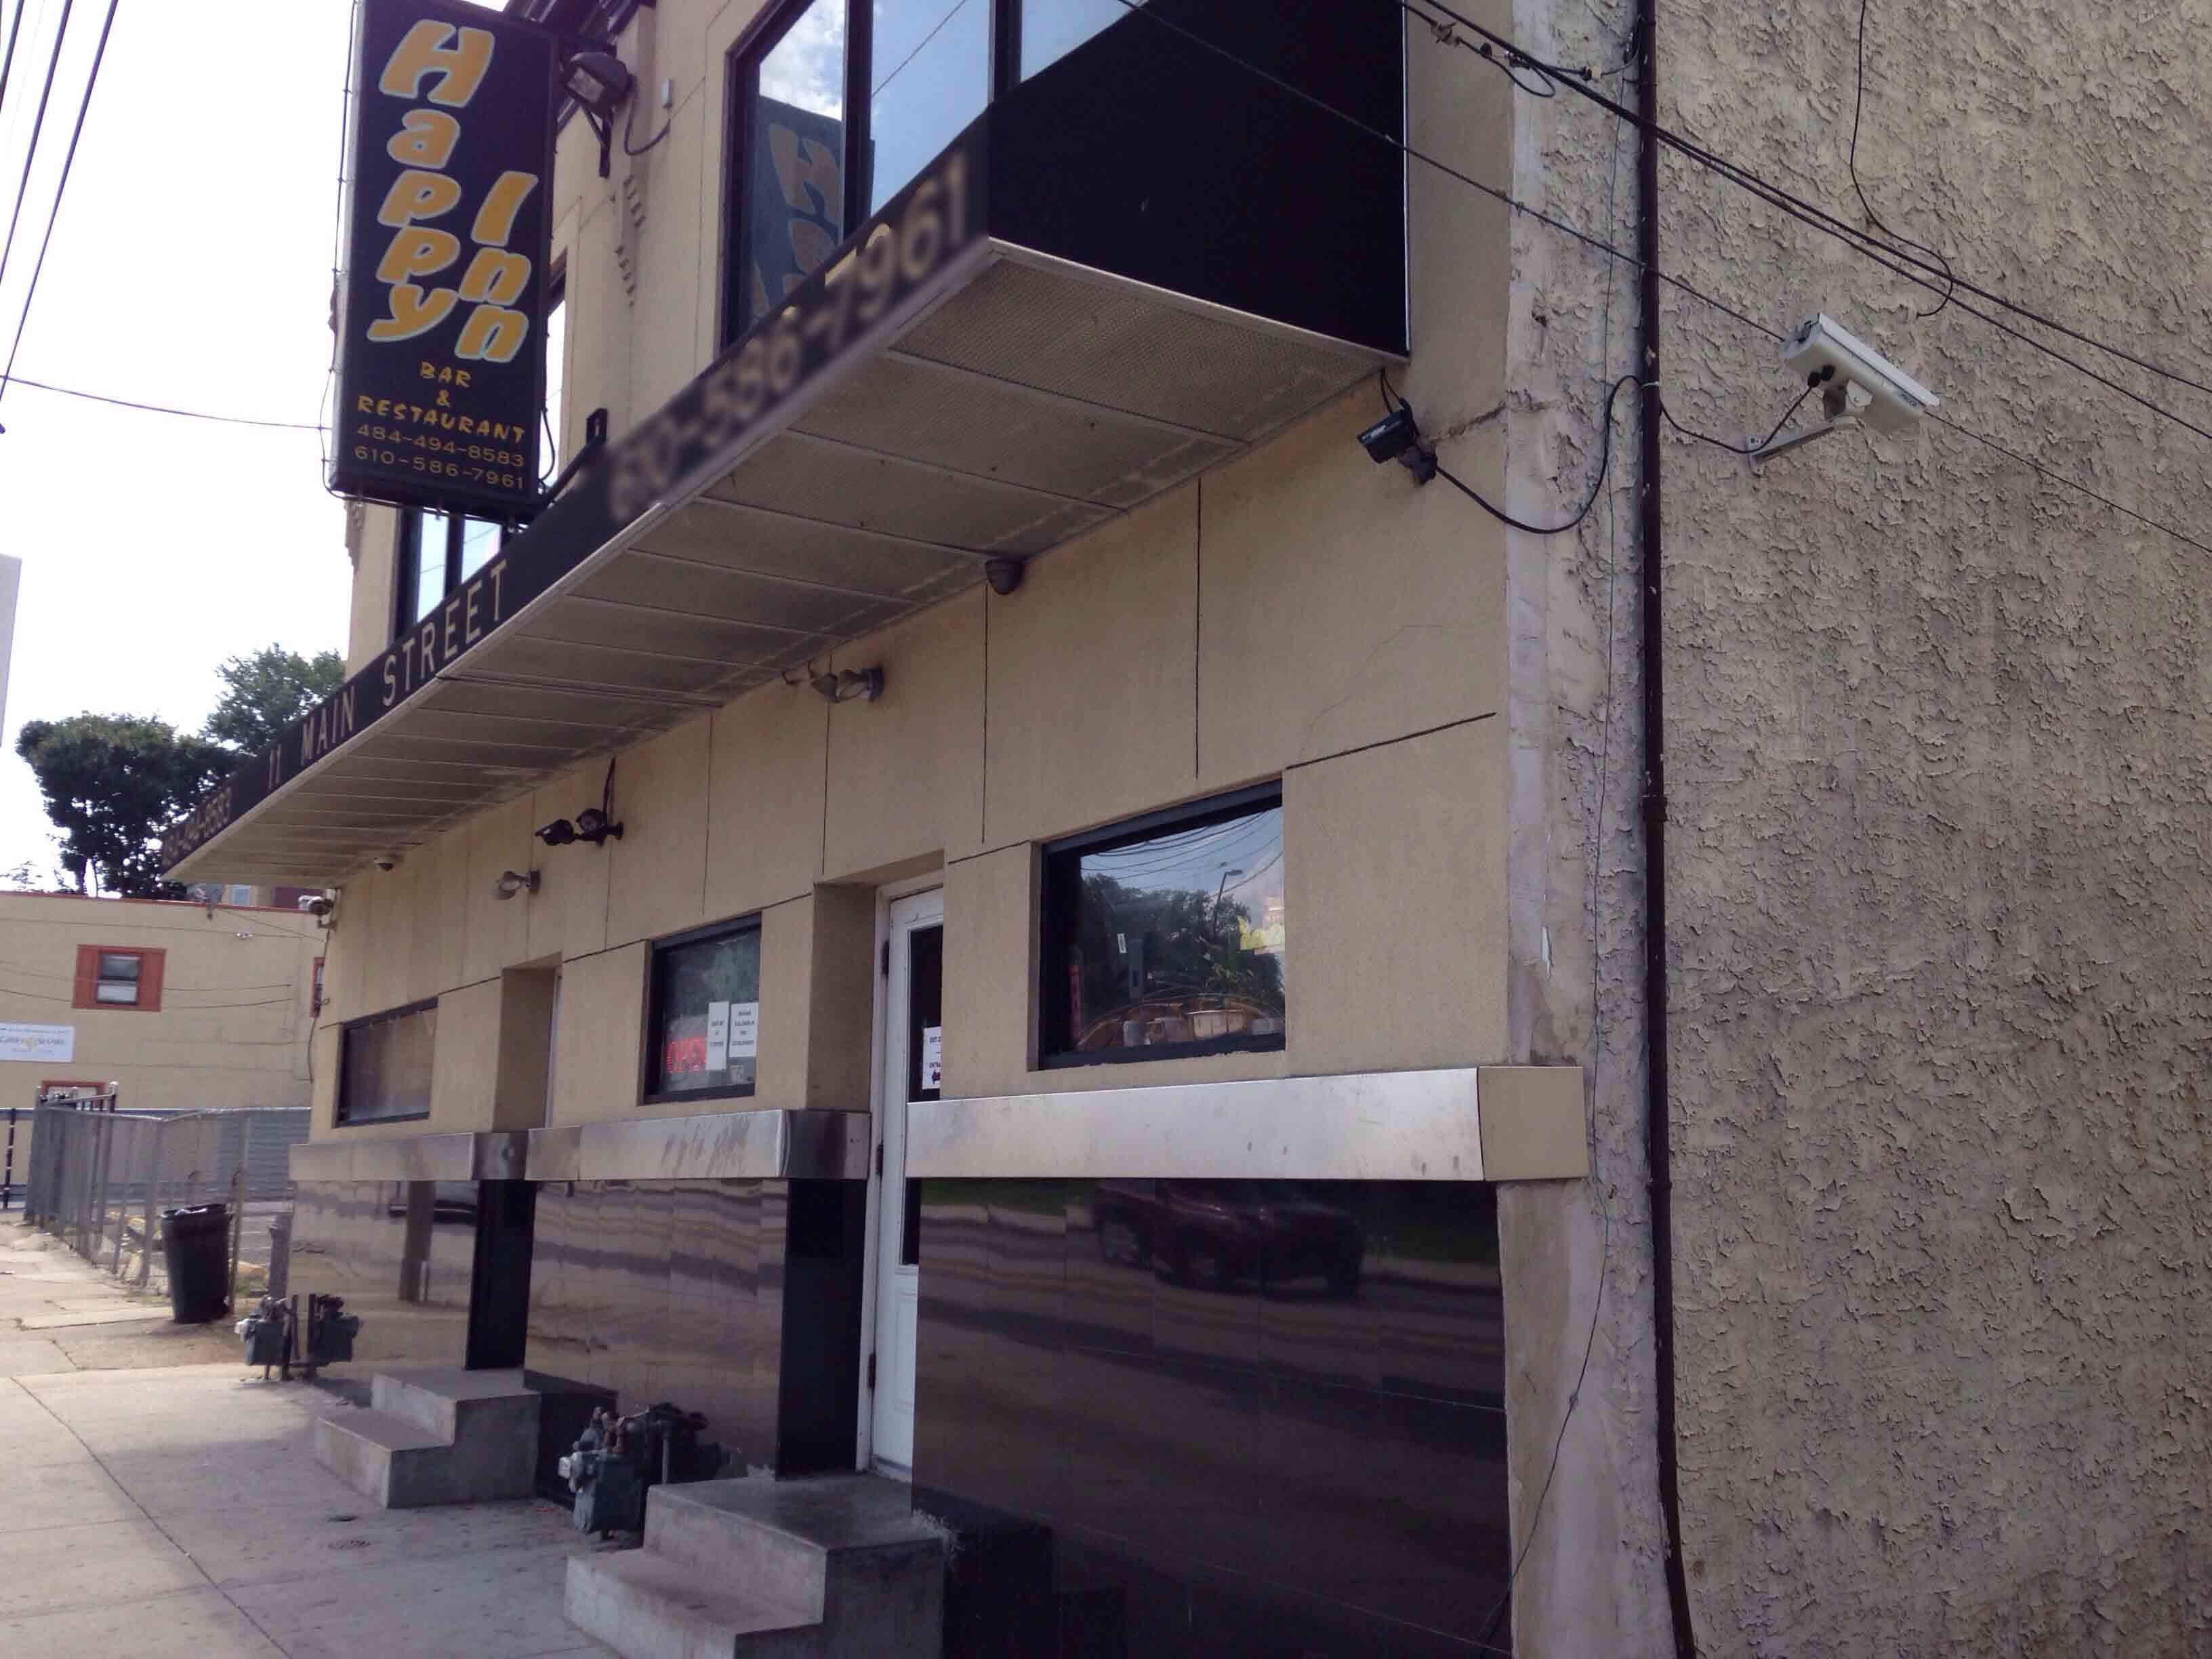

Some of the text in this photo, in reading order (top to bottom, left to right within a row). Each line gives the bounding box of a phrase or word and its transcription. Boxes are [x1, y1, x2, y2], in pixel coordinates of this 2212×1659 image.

[367, 19, 495, 342] Happy
[454, 170, 539, 363] Inn
[419, 361, 472, 388] BAR
[357, 395, 525, 443] RESTAURANT
[436, 389, 451, 407] &
[354, 445, 525, 489] 610-586-7961
[356, 424, 525, 468] 484-494-8583
[301, 684, 355, 765] MAIN
[382, 558, 508, 706] STREET
